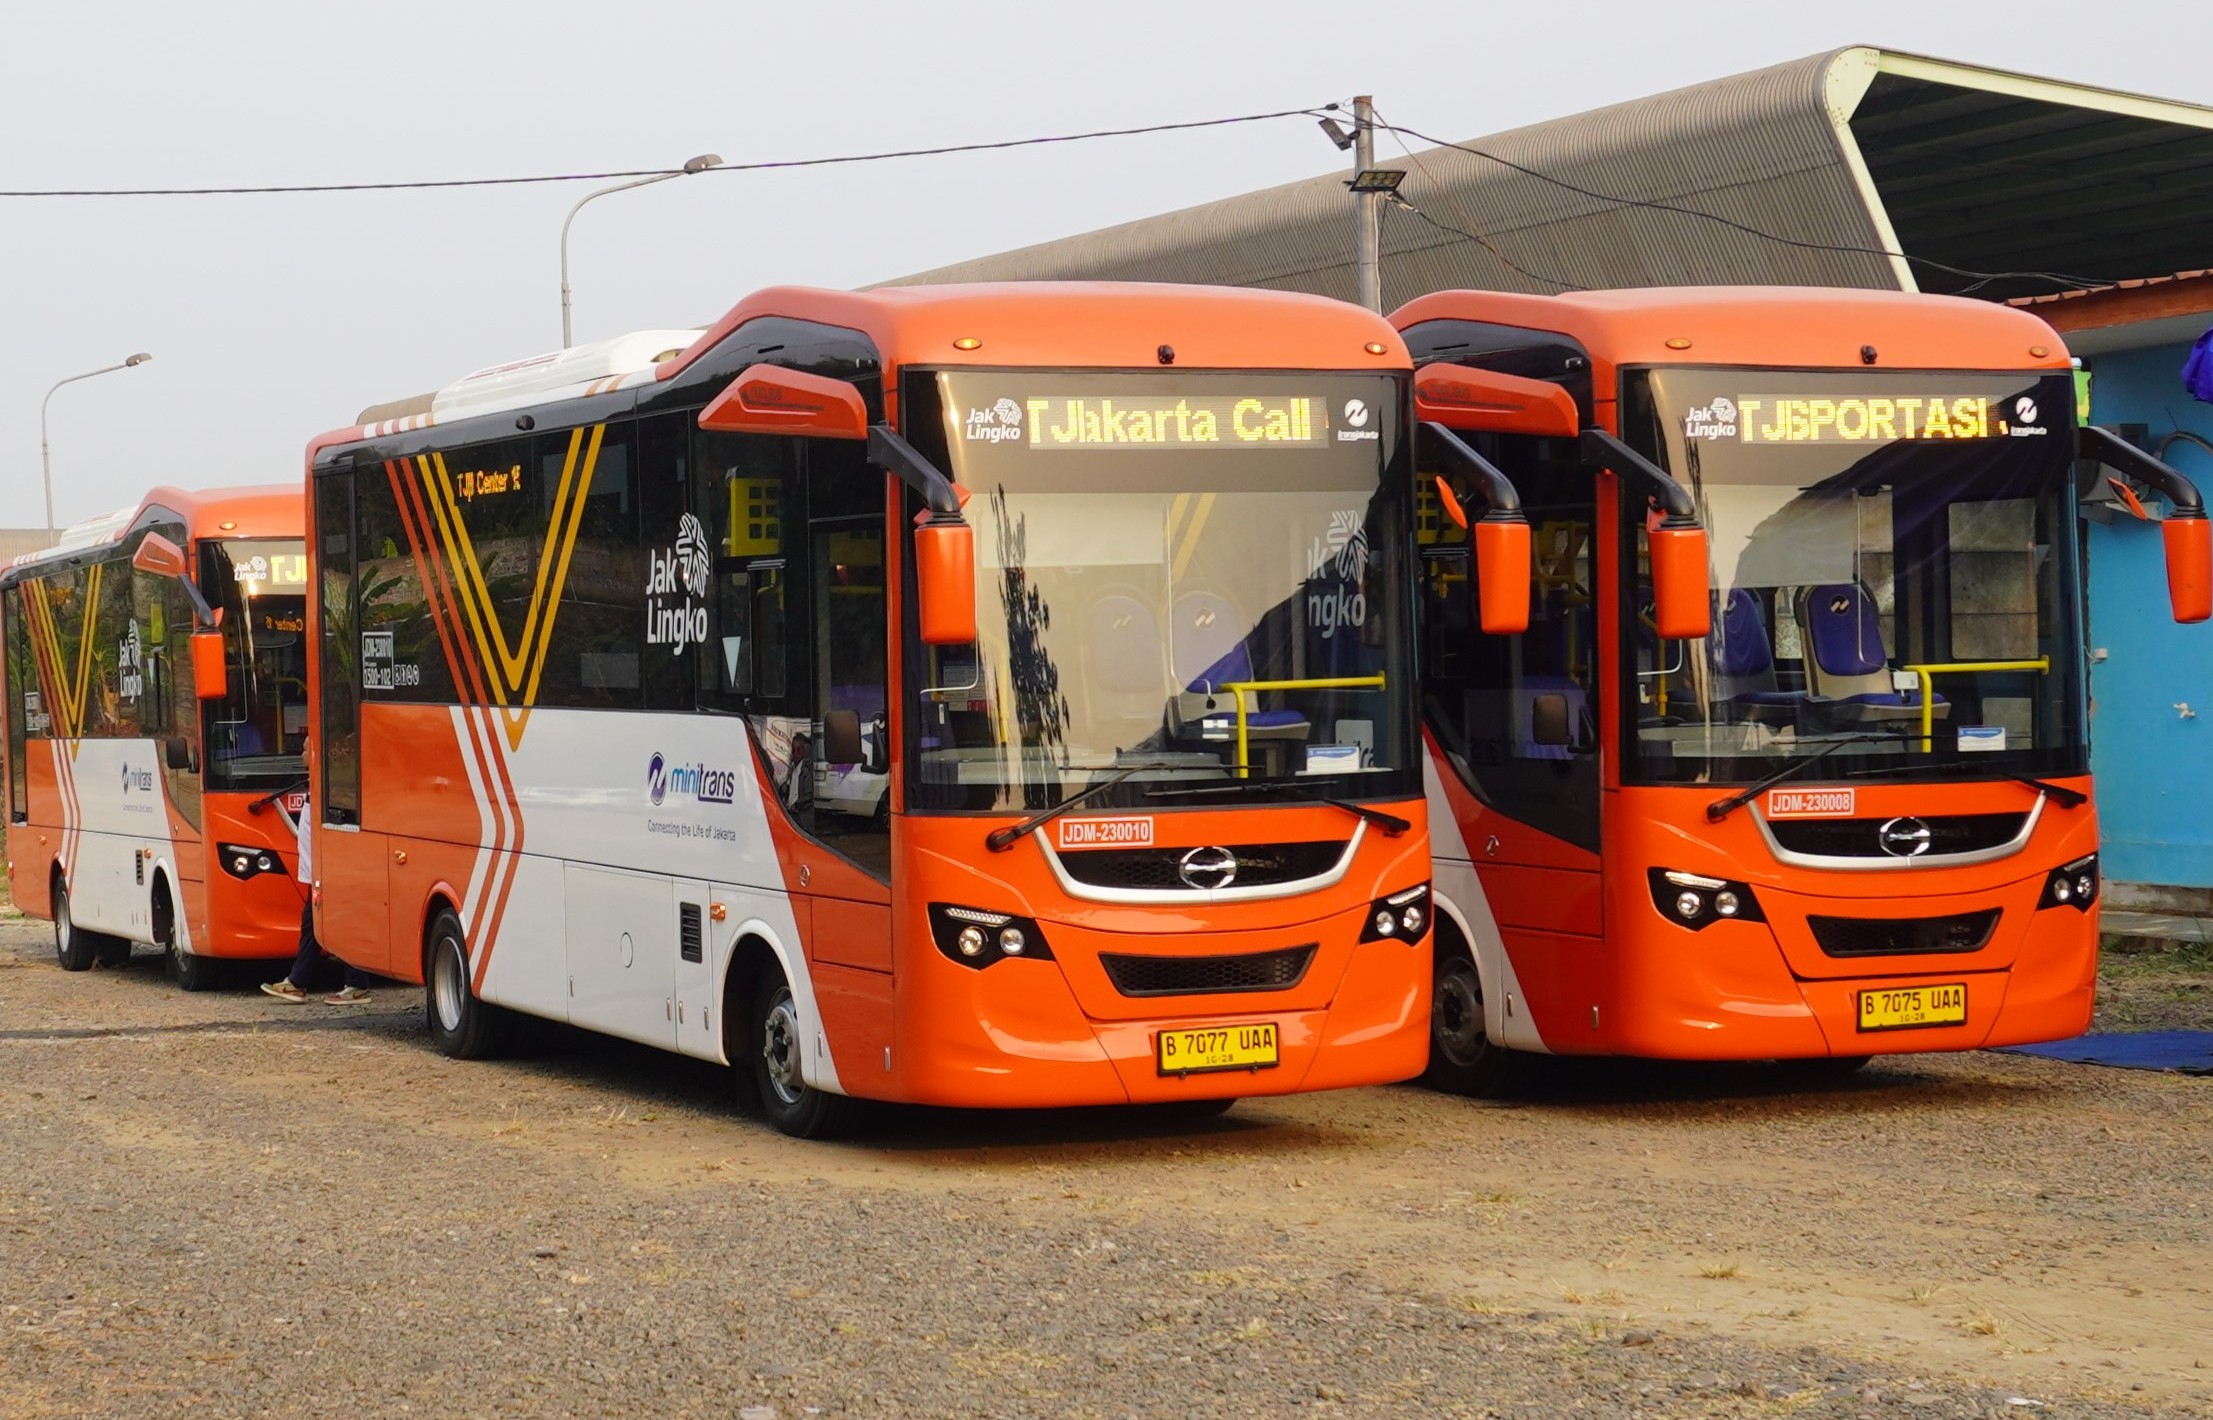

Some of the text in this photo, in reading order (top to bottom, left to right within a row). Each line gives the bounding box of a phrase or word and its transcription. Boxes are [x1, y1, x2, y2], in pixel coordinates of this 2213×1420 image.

[966, 408, 995, 424] Jak
[1233, 398, 1311, 441] Call
[1686, 407, 1712, 422] Jak
[966, 424, 1021, 443] Lingko
[1686, 421, 1737, 440] Lingko
[646, 548, 677, 595] Jak
[1308, 583, 1366, 639] ngko
[647, 596, 708, 656] Lingko
[671, 762, 735, 801] minitrans
[1773, 793, 1850, 812] JDM-230008
[648, 819, 736, 841] Connecting the Life of Jakarta
[1065, 822, 1149, 842] JDM-230010
[1865, 989, 1961, 1015] B 7075 UAA
[1166, 1028, 1273, 1056] B 7077 UAA
